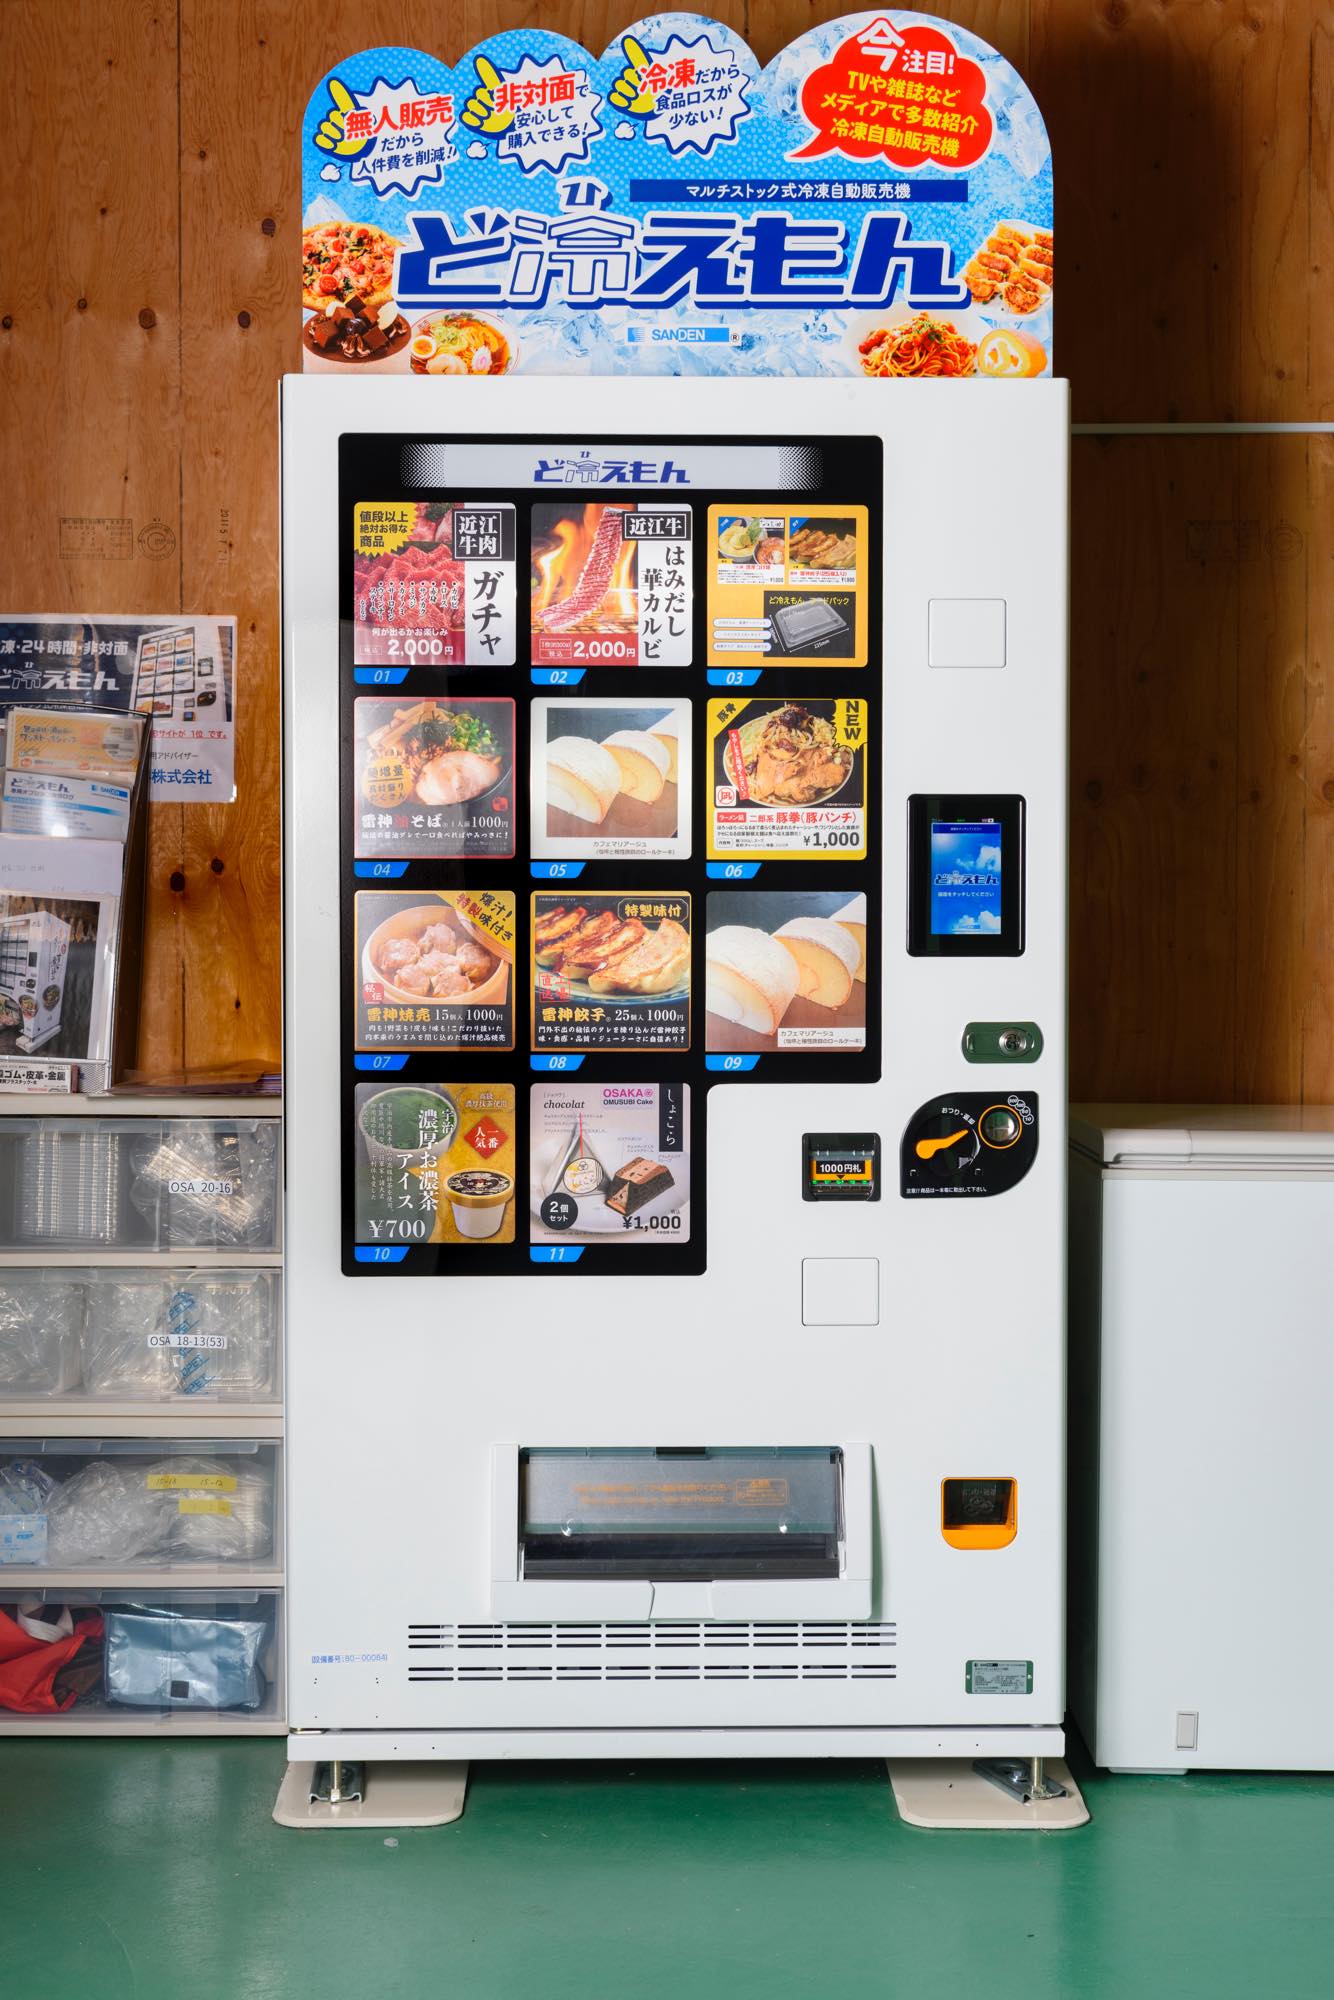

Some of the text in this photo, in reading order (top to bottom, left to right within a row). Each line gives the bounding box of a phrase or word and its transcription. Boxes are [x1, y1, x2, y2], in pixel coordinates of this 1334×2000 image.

[640, 58, 741, 94] 冷凍だから
[494, 73, 590, 113] 非対面で
[655, 83, 733, 112] 食品ロスが
[847, 70, 961, 108] TVや雑誌など
[345, 95, 454, 139] 無人販売
[515, 106, 574, 129] 安心して
[669, 106, 724, 130] 少ない!
[820, 92, 979, 137] メディアで多数紹介
[380, 131, 424, 153] だから
[508, 123, 589, 151] 購入できる!
[830, 117, 961, 159] 冷凍自動販売機
[685, 182, 912, 200] マルチストック式冷凍自動販売機
[397, 212, 969, 308] ど冷えもん
[651, 328, 706, 343] SANDEN
[533, 459, 691, 483] ど冷えもん
[359, 510, 409, 523] 値段以上
[359, 523, 408, 534] 絶対お得な
[629, 517, 683, 536] 近江牛
[359, 535, 385, 548] 商品
[664, 546, 687, 637] はみだし
[471, 571, 504, 656] ガチャ
[641, 568, 663, 660] 華カルビ
[371, 627, 449, 637] 何が出るかお楽しみ
[387, 638, 454, 657] 2,000円
[573, 640, 636, 659] 2,000円
[373, 670, 391, 682] 01
[550, 671, 568, 683] 02
[725, 672, 744, 685] 03
[844, 700, 862, 741] NEW
[208, 730, 228, 740] です。
[151, 769, 213, 785] 株式会社
[803, 831, 860, 849] ¥1,000
[373, 864, 391, 876] 04
[549, 864, 567, 877] 05
[724, 865, 743, 878] 06
[456, 892, 513, 941] 特製味付き
[624, 903, 682, 917] 特製味付
[367, 1007, 432, 1023] 雷神焼売
[466, 1009, 504, 1021] 1000円
[541, 1007, 606, 1023] 雷神餃子
[647, 1009, 684, 1021] 1000円
[373, 1056, 392, 1069] 07
[549, 1056, 567, 1069] 08
[724, 1057, 742, 1069] 09
[603, 1088, 645, 1098] OSAKA
[543, 1099, 585, 1109] chocolat
[441, 1109, 455, 1134] 宇治
[666, 1089, 677, 1146] しょこら
[418, 1109, 439, 1211] 濃厚お濃茶
[820, 1164, 862, 1173] 1000円札
[170, 1181, 231, 1194] OSA 20-16
[396, 1154, 414, 1209] アイス
[549, 1201, 569, 1213] 2個
[368, 1219, 426, 1238] ¥700
[622, 1215, 682, 1232] ¥1,000
[374, 1248, 391, 1260] 10
[550, 1248, 565, 1260] 11
[149, 1336, 226, 1348] OSA 18-13(53)
